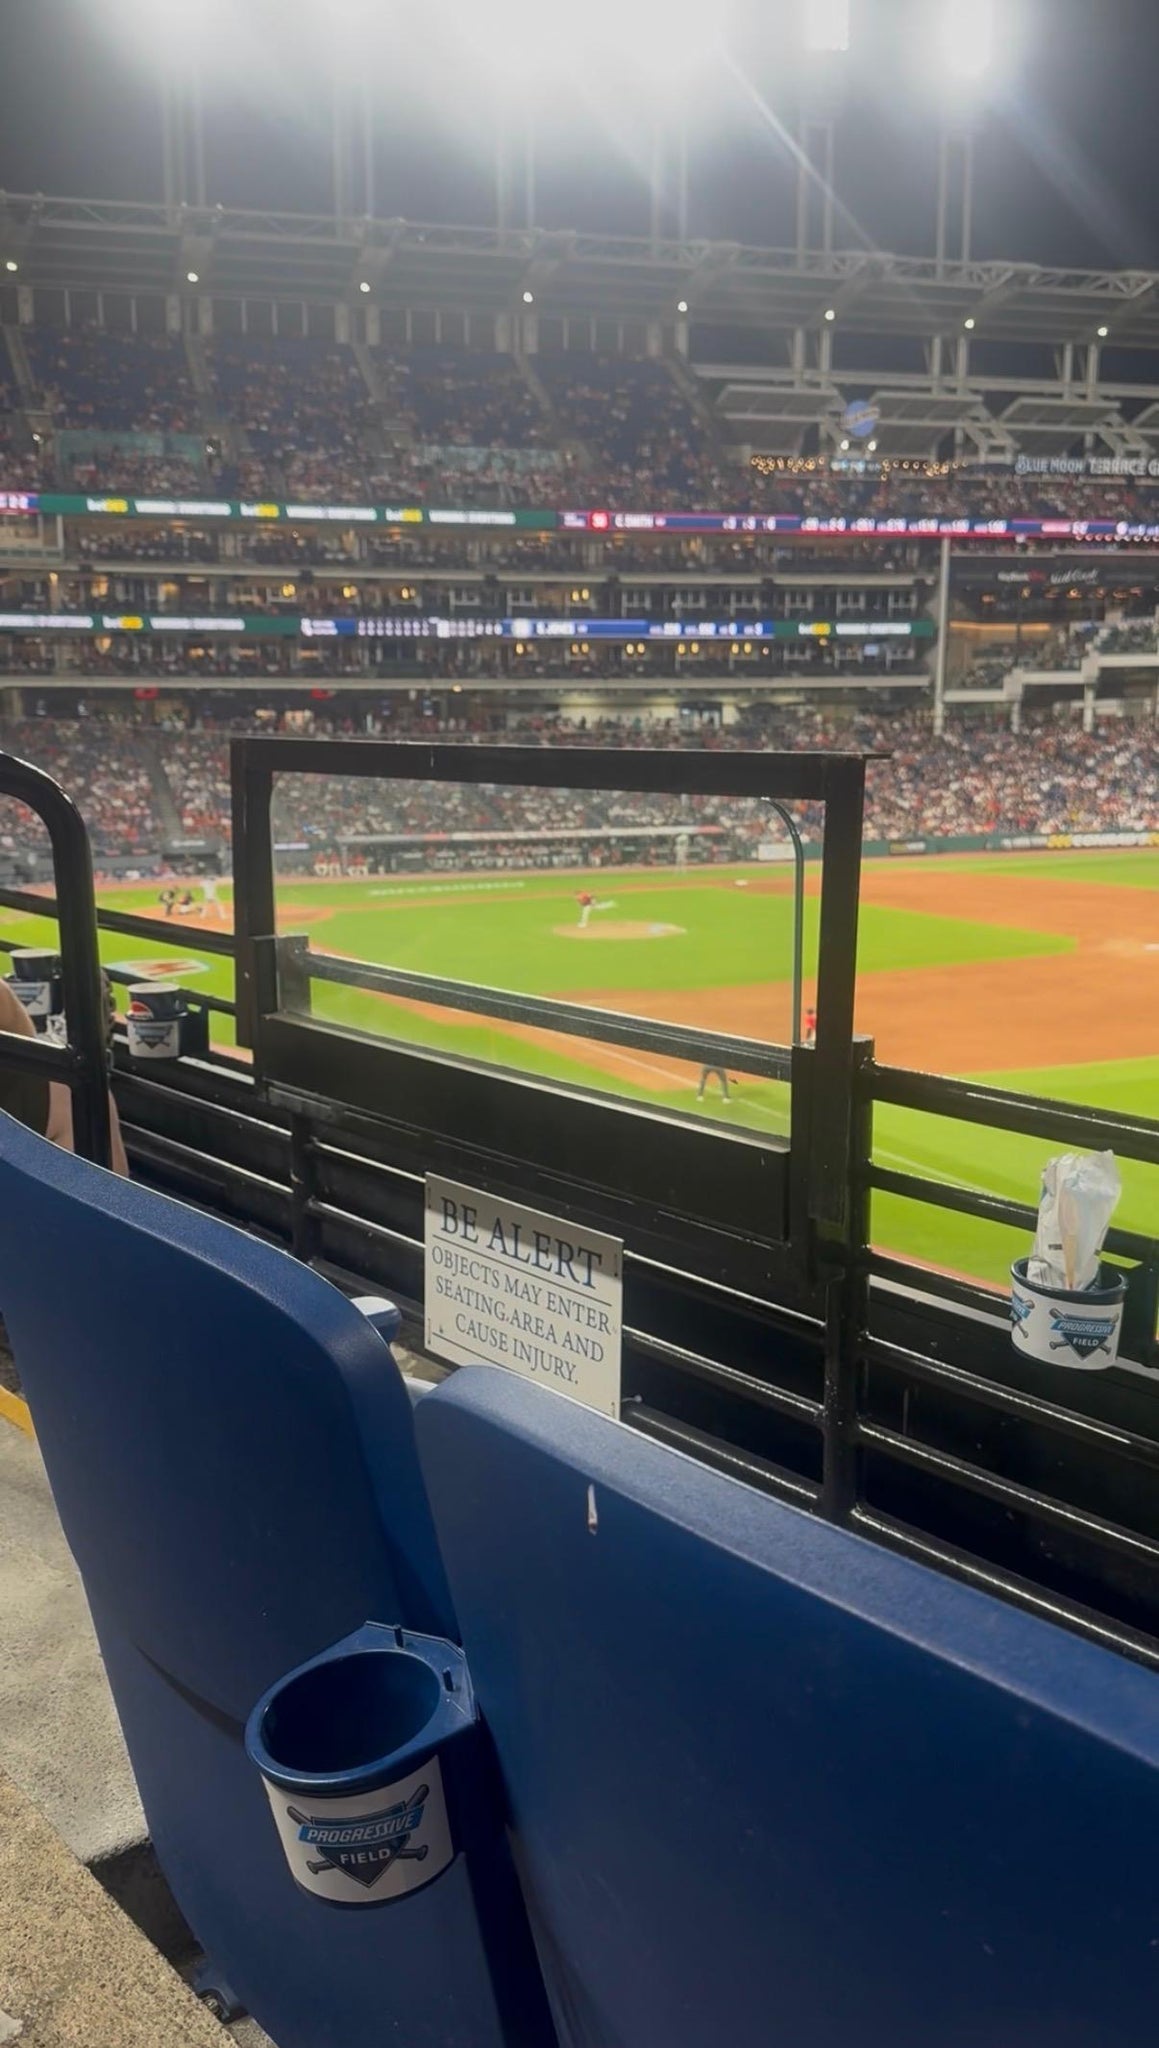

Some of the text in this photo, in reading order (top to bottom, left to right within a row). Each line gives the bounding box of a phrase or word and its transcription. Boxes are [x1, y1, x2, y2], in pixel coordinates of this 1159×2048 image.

[1015, 456, 1048, 474] BLUE
[1050, 458, 1084, 473] MOON
[1089, 459, 1146, 476] TERRACE
[440, 1196, 602, 1290] BE ALERT
[431, 1245, 612, 1336] OBJECTS MAY ENTER
[436, 1275, 604, 1363] SEATING AREA AND
[1072, 1337, 1099, 1347] FIELD
[455, 1313, 579, 1385] CAUSE INJURY.
[306, 1812, 415, 1843] PROGRESSIVE
[340, 1849, 391, 1865] FIELD
